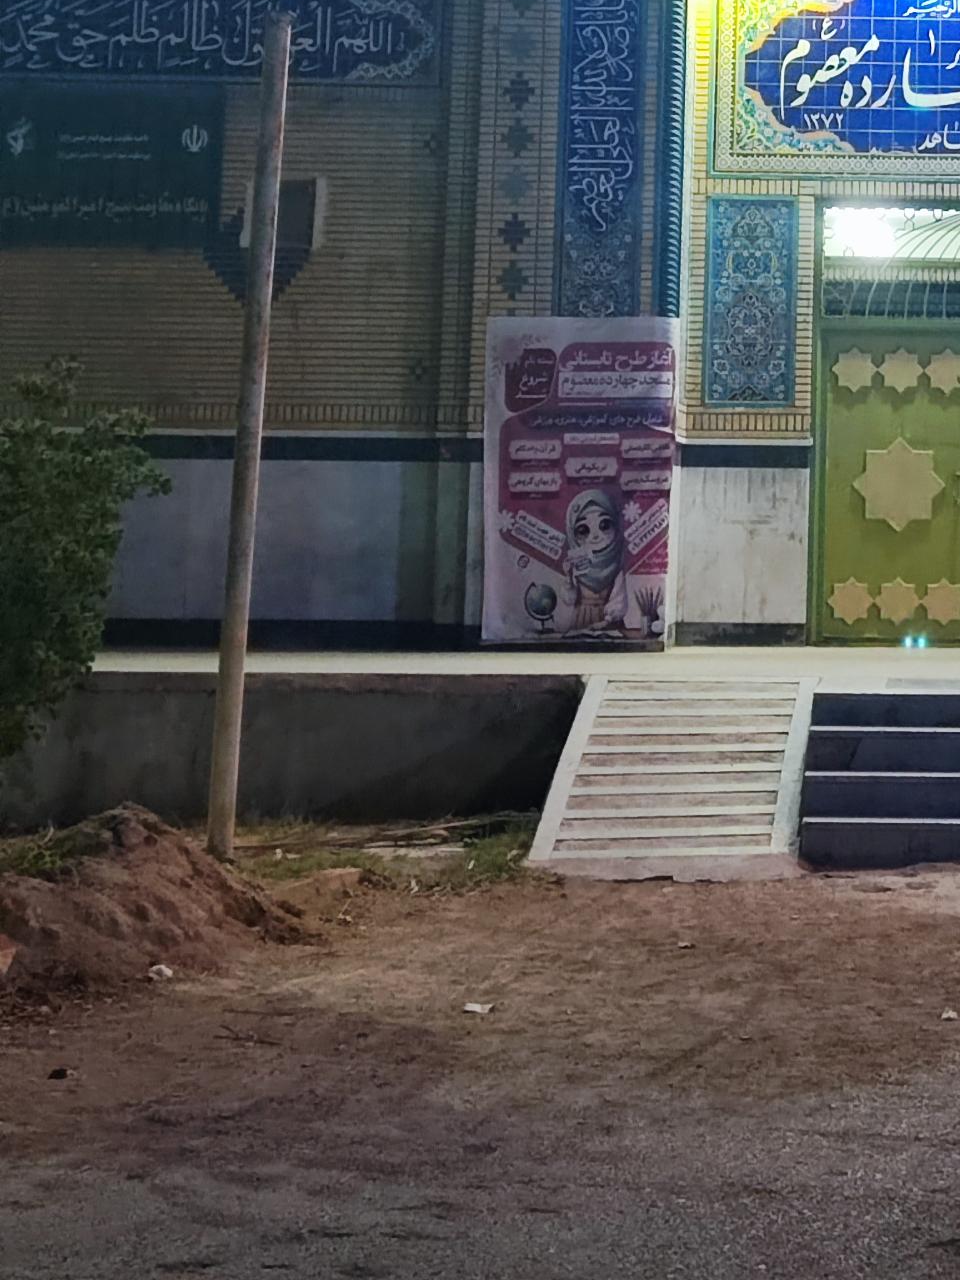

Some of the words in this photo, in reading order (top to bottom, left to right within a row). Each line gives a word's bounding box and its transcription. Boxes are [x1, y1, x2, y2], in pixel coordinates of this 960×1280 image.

[779, 33, 881, 121] معصوم
[559, 349, 613, 371] تابستانی
[614, 350, 648, 372] طرح
[646, 347, 674, 369] آغاز
